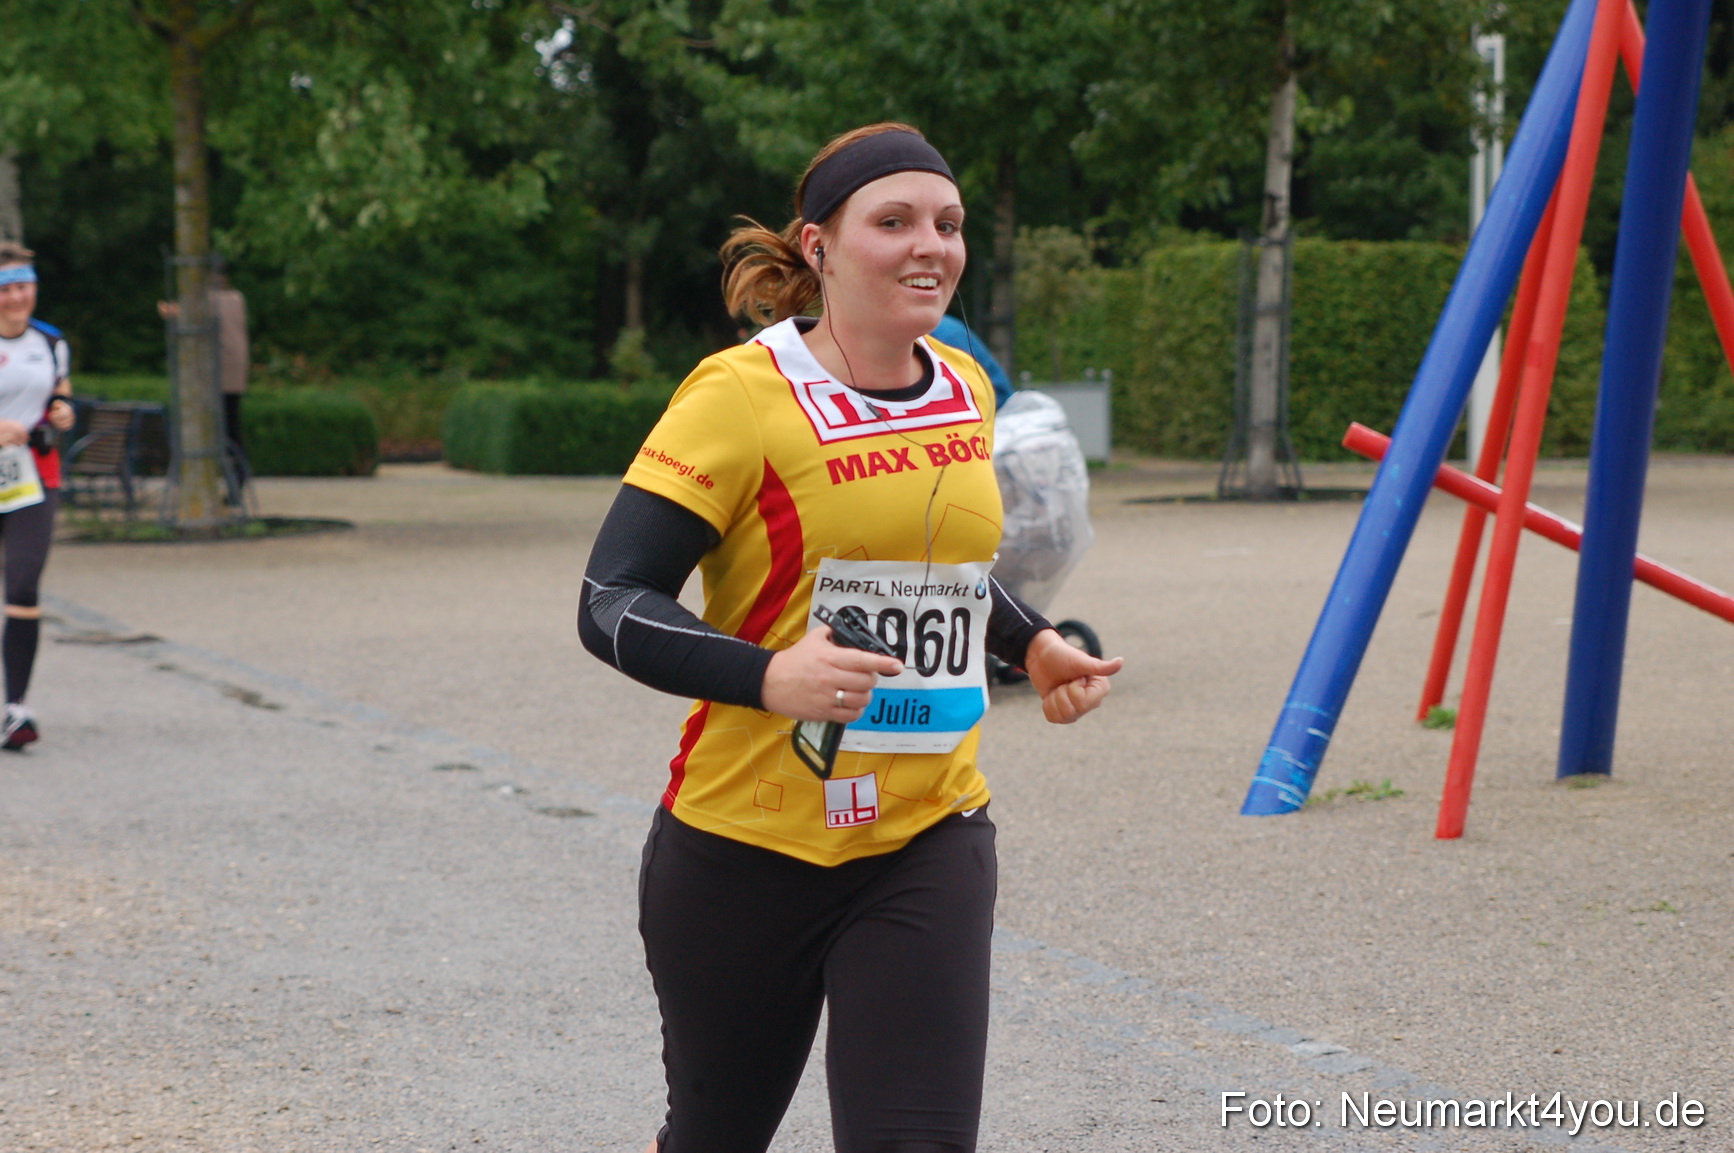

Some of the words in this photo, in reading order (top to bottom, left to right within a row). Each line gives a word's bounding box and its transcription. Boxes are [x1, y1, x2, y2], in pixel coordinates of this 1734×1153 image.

[826, 447, 919, 485] MAX
[819, 577, 885, 596] PARTL
[891, 581, 970, 597] Neumarkt
[836, 605, 970, 678] 960
[870, 698, 931, 725] Julia
